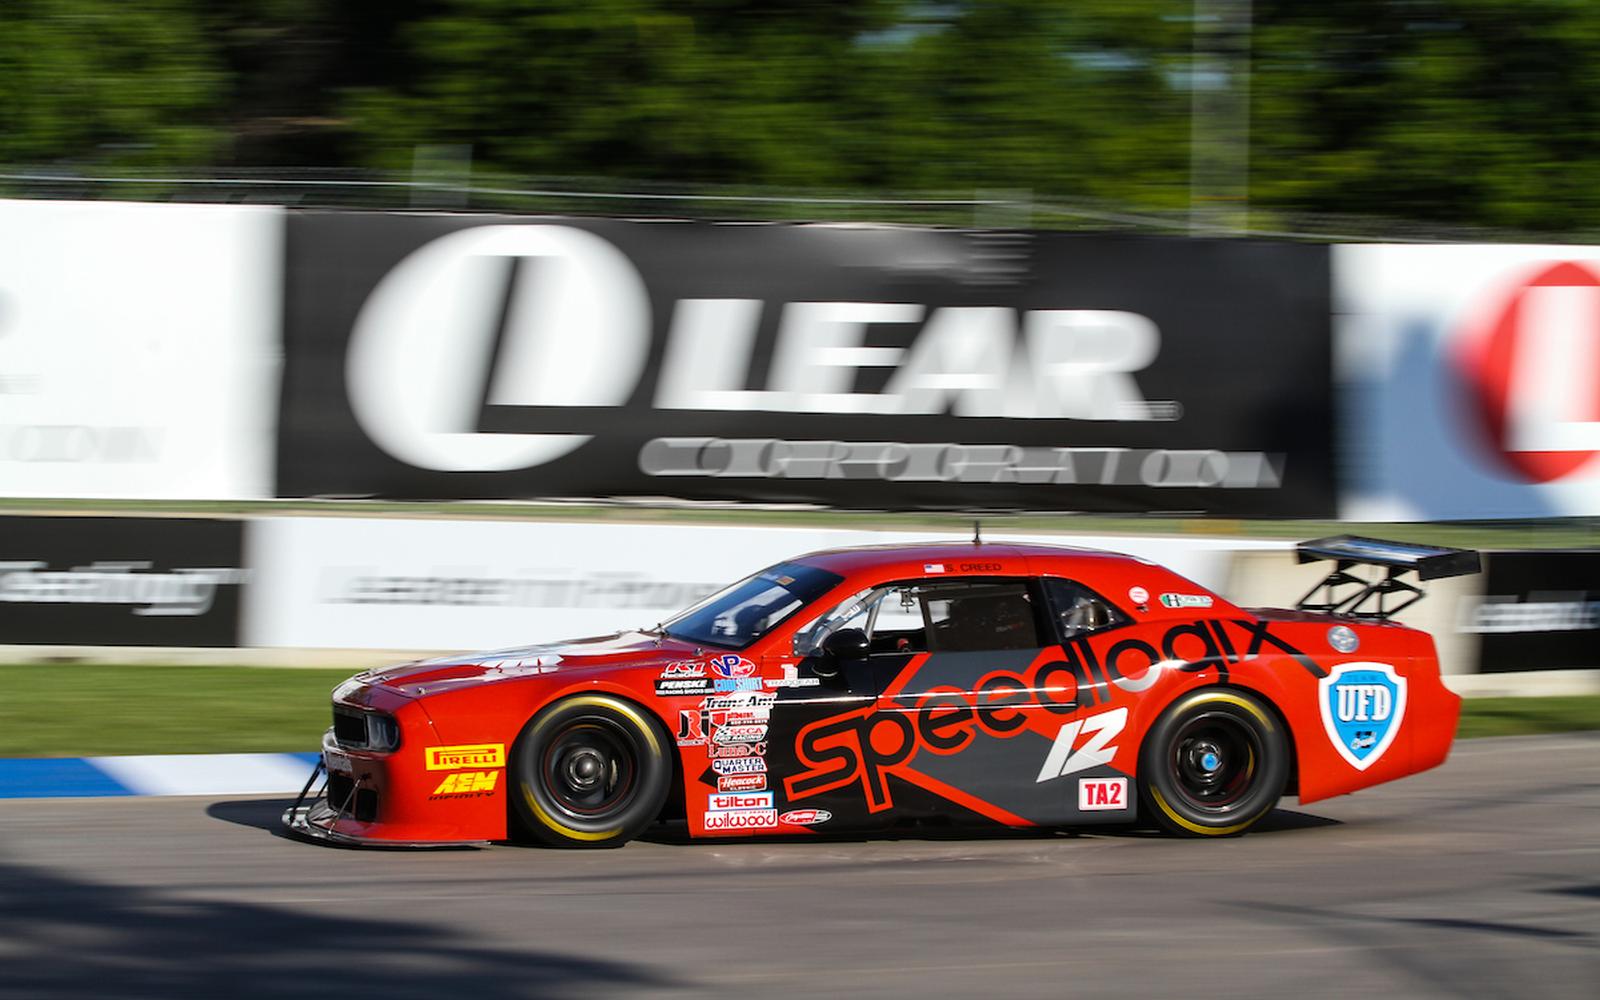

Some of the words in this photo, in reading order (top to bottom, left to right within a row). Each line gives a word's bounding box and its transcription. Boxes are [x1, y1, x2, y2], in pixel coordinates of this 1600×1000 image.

[654, 299, 1162, 421] LEAR
[960, 563, 1002, 572] CREED
[711, 655, 740, 677] VP
[659, 679, 707, 689] PENSKE
[706, 697, 745, 709] Trans
[746, 696, 775, 707] Am
[1336, 684, 1392, 722] UFD
[730, 727, 763, 735] SCCA
[1036, 707, 1128, 783] 12
[433, 748, 497, 765] PIRELLI
[713, 758, 762, 769] QUARTER
[722, 765, 765, 774] MASTER
[433, 770, 499, 794] AEM
[713, 796, 768, 808] tilton
[1084, 783, 1122, 805] TA2
[706, 810, 776, 828] wilwood
